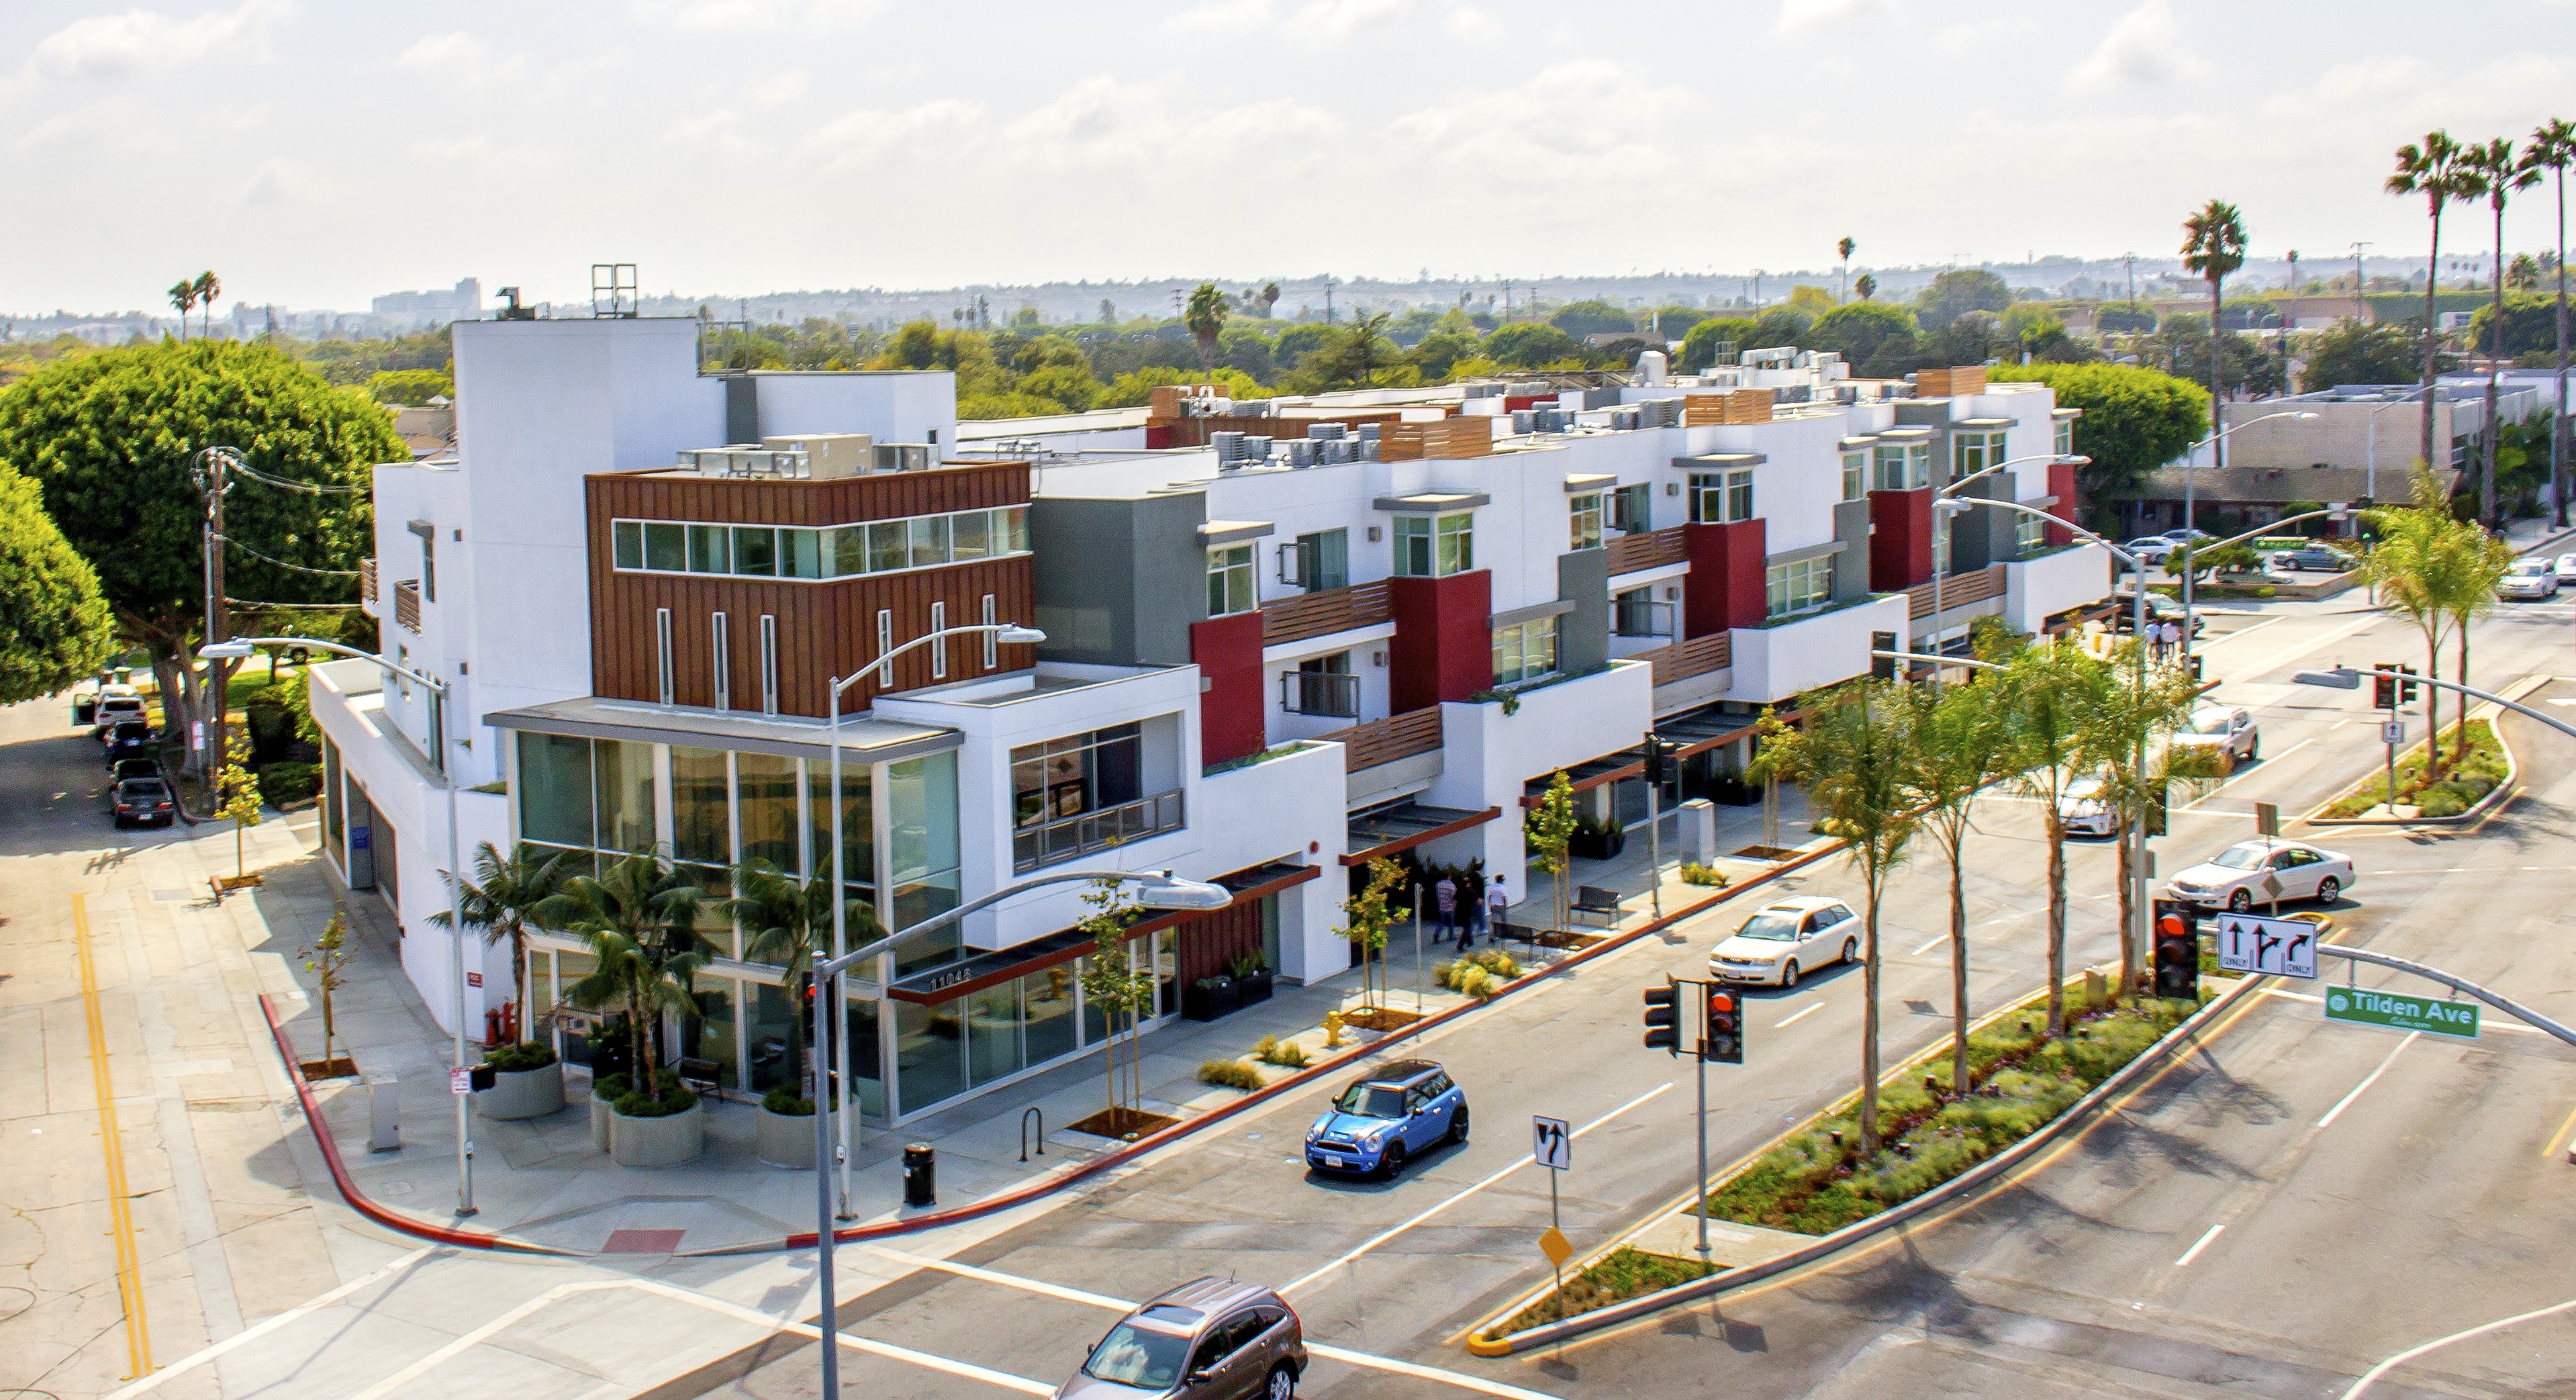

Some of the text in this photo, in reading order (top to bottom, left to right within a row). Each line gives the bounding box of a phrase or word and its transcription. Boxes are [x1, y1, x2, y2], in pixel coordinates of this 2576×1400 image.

[2223, 956, 2248, 968] ONLY
[2286, 964, 2311, 974] ONLY
[2351, 991, 2420, 1017] Tilden
[2424, 1002, 2473, 1024] Ave
